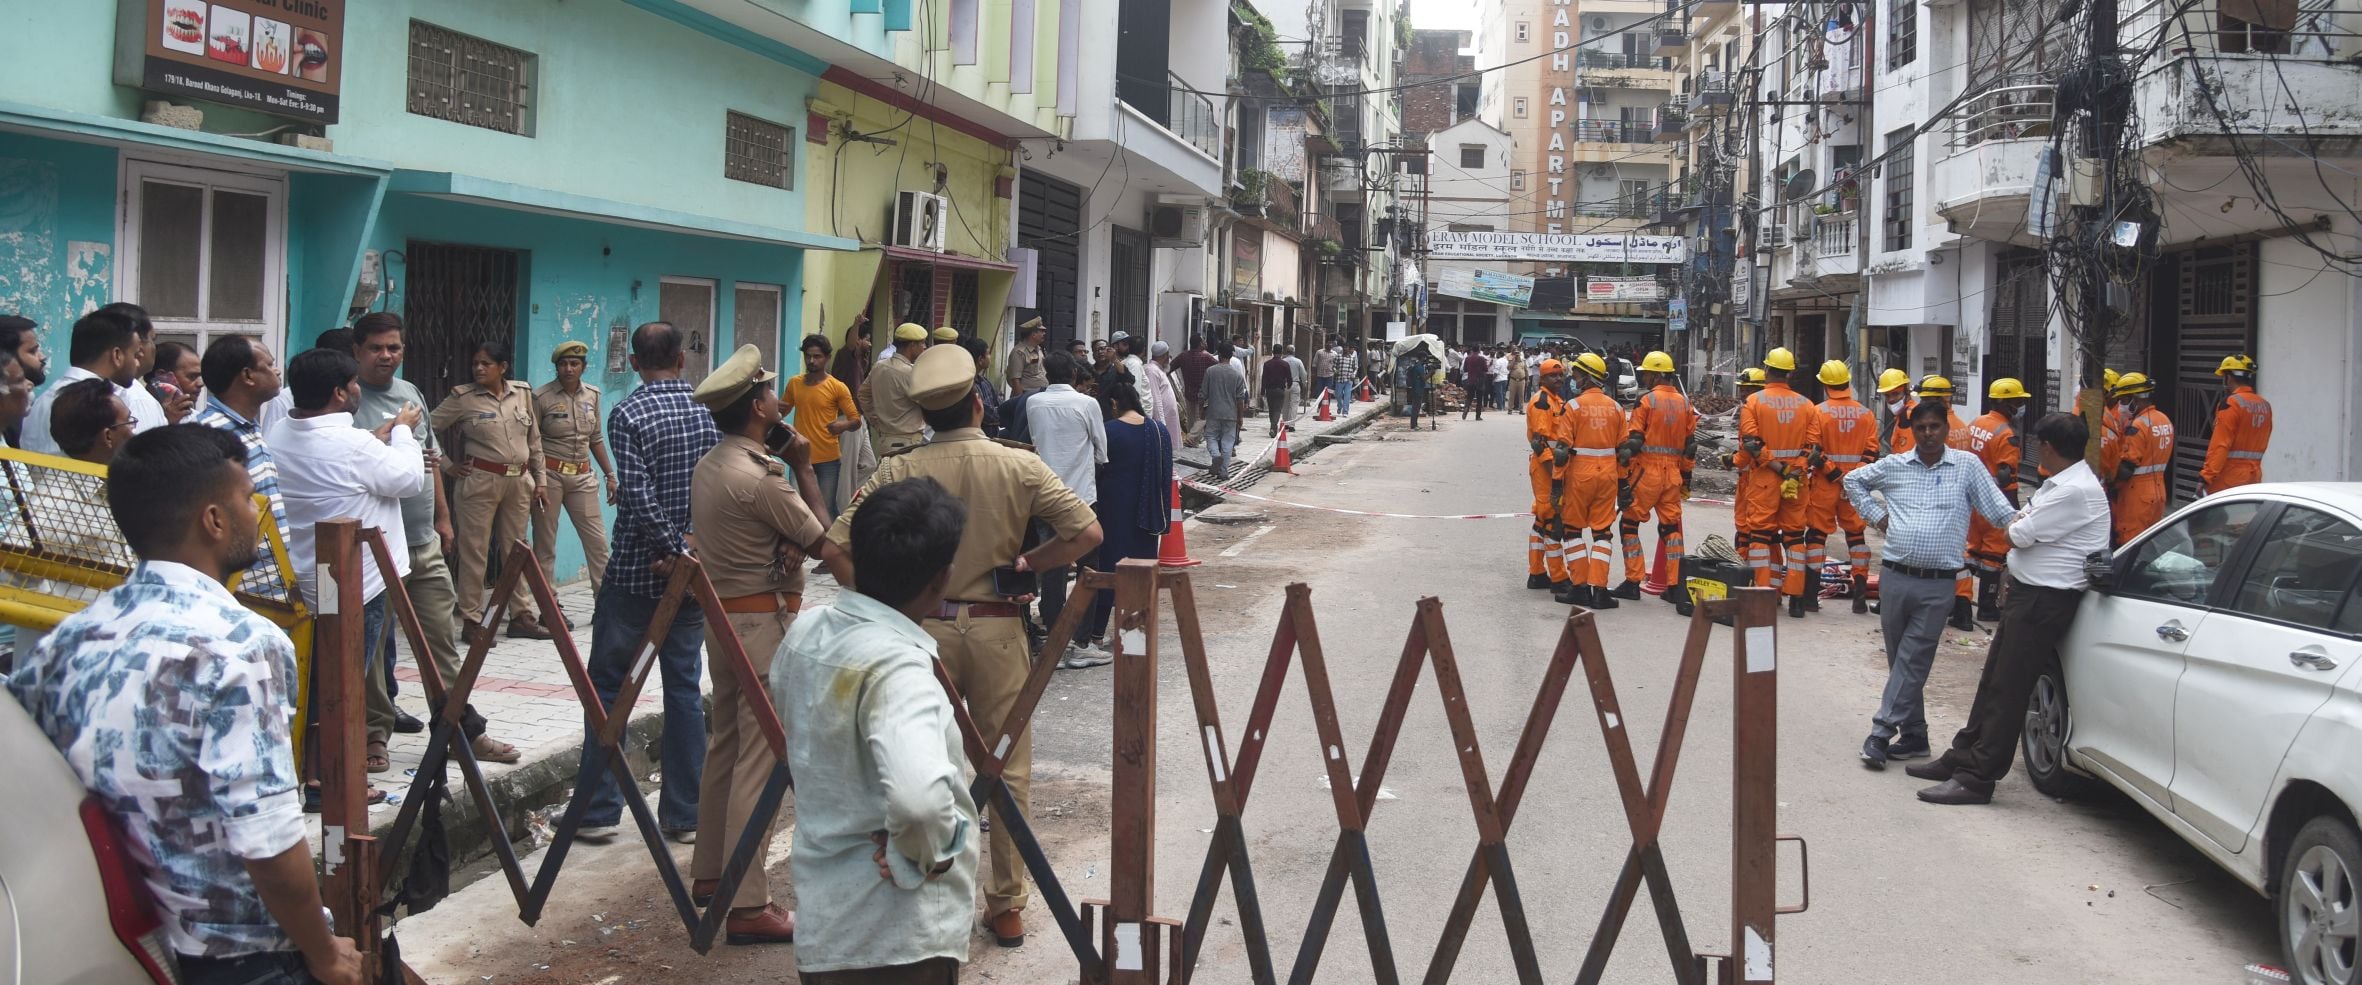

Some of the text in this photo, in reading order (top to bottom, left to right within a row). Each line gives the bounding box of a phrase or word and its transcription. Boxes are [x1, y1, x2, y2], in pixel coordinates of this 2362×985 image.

[283, 0, 329, 20] Clinic
[1552, 0, 1571, 72] ADH
[204, 81, 220, 93] Khana
[266, 95, 288, 106] Mon-Sat
[316, 106, 325, 114] pm
[1546, 87, 1568, 277] APARTME
[1432, 231, 1582, 246] ERAM MODEL SCHOOL
[1432, 243, 1453, 251] इरम
[1493, 245, 1517, 254] स्कूल
[1580, 405, 1617, 418] SDRF
[1777, 410, 1795, 424] UP
[1830, 406, 1862, 419] SDRF
[1590, 418, 1608, 430] UP
[1838, 419, 1856, 432] UP
[1949, 428, 1970, 441] SDR
[1970, 425, 1993, 442] SDRF
[1971, 438, 1984, 452] UP
